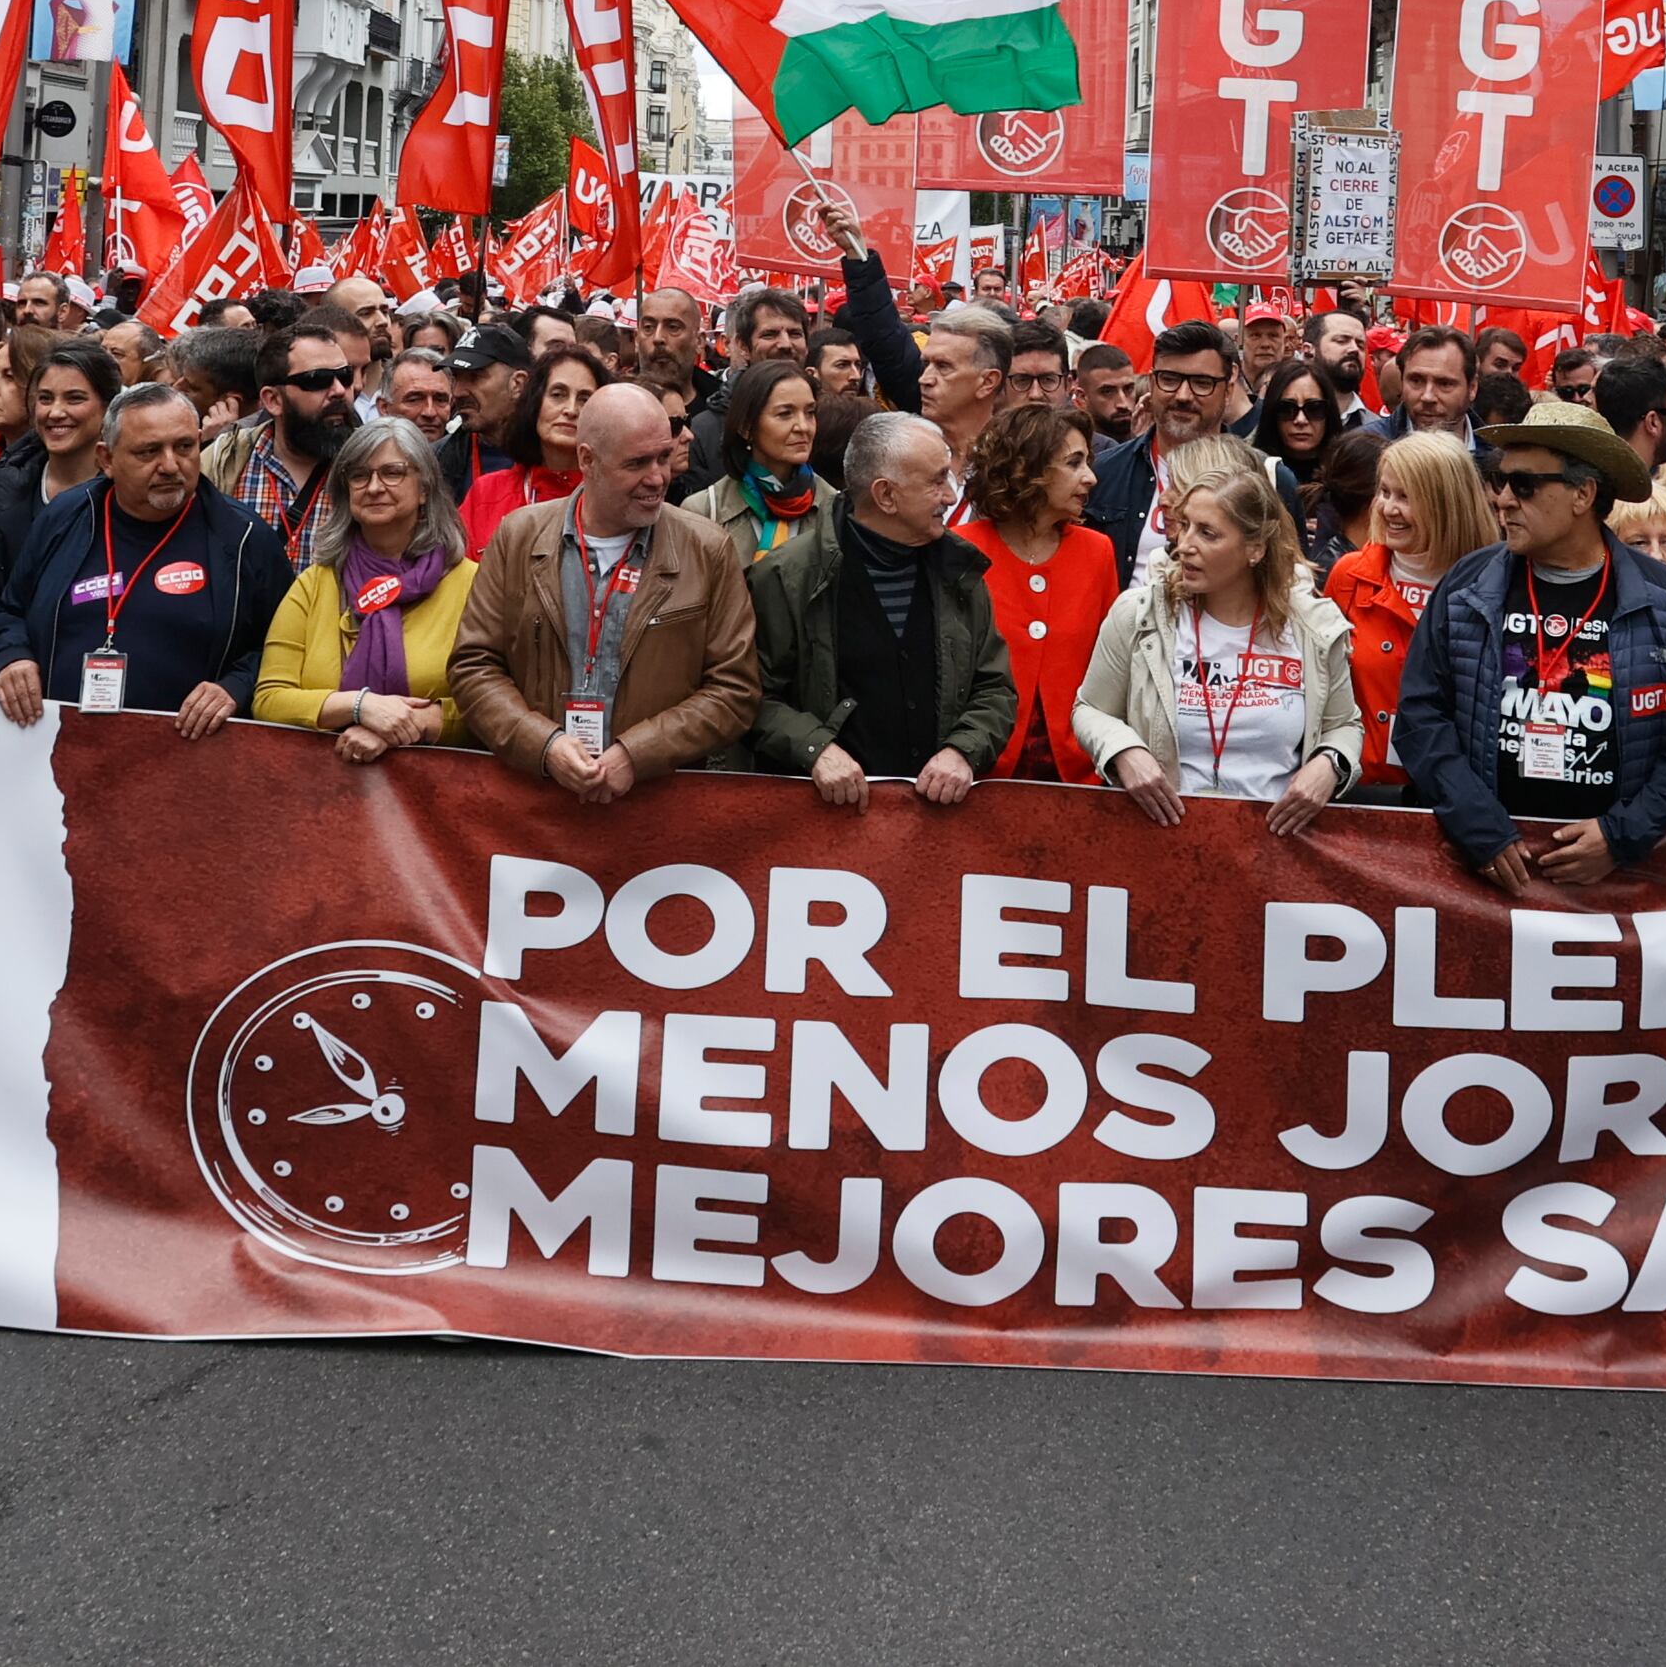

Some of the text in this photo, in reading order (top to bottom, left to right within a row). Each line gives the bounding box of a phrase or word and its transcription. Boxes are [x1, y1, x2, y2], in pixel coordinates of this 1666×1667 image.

[1335, 161, 1375, 173] NO AL
[1608, 164, 1640, 172] ACERA
[1329, 179, 1379, 192] CIERRE
[1346, 198, 1363, 211] DE
[1308, 186, 1321, 250] ALSTOM
[1324, 215, 1383, 229] ALSTOM
[1326, 232, 1378, 245] GETAFE
[1304, 259, 1358, 271] ALSTOM
[157, 569, 204, 585] CCOO
[358, 578, 399, 609] CCOO
[1238, 657, 1283, 679] UGT
[1180, 689, 1216, 699] MENS
[1633, 689, 1663, 712] UGT
[1231, 698, 1280, 708] ALARIOS
[1564, 768, 1614, 785] arios
[483, 853, 893, 998] POR
[959, 872, 1196, 1014] EL
[474, 999, 1216, 1162] MENOS
[466, 1144, 1436, 1315] MEJORES
